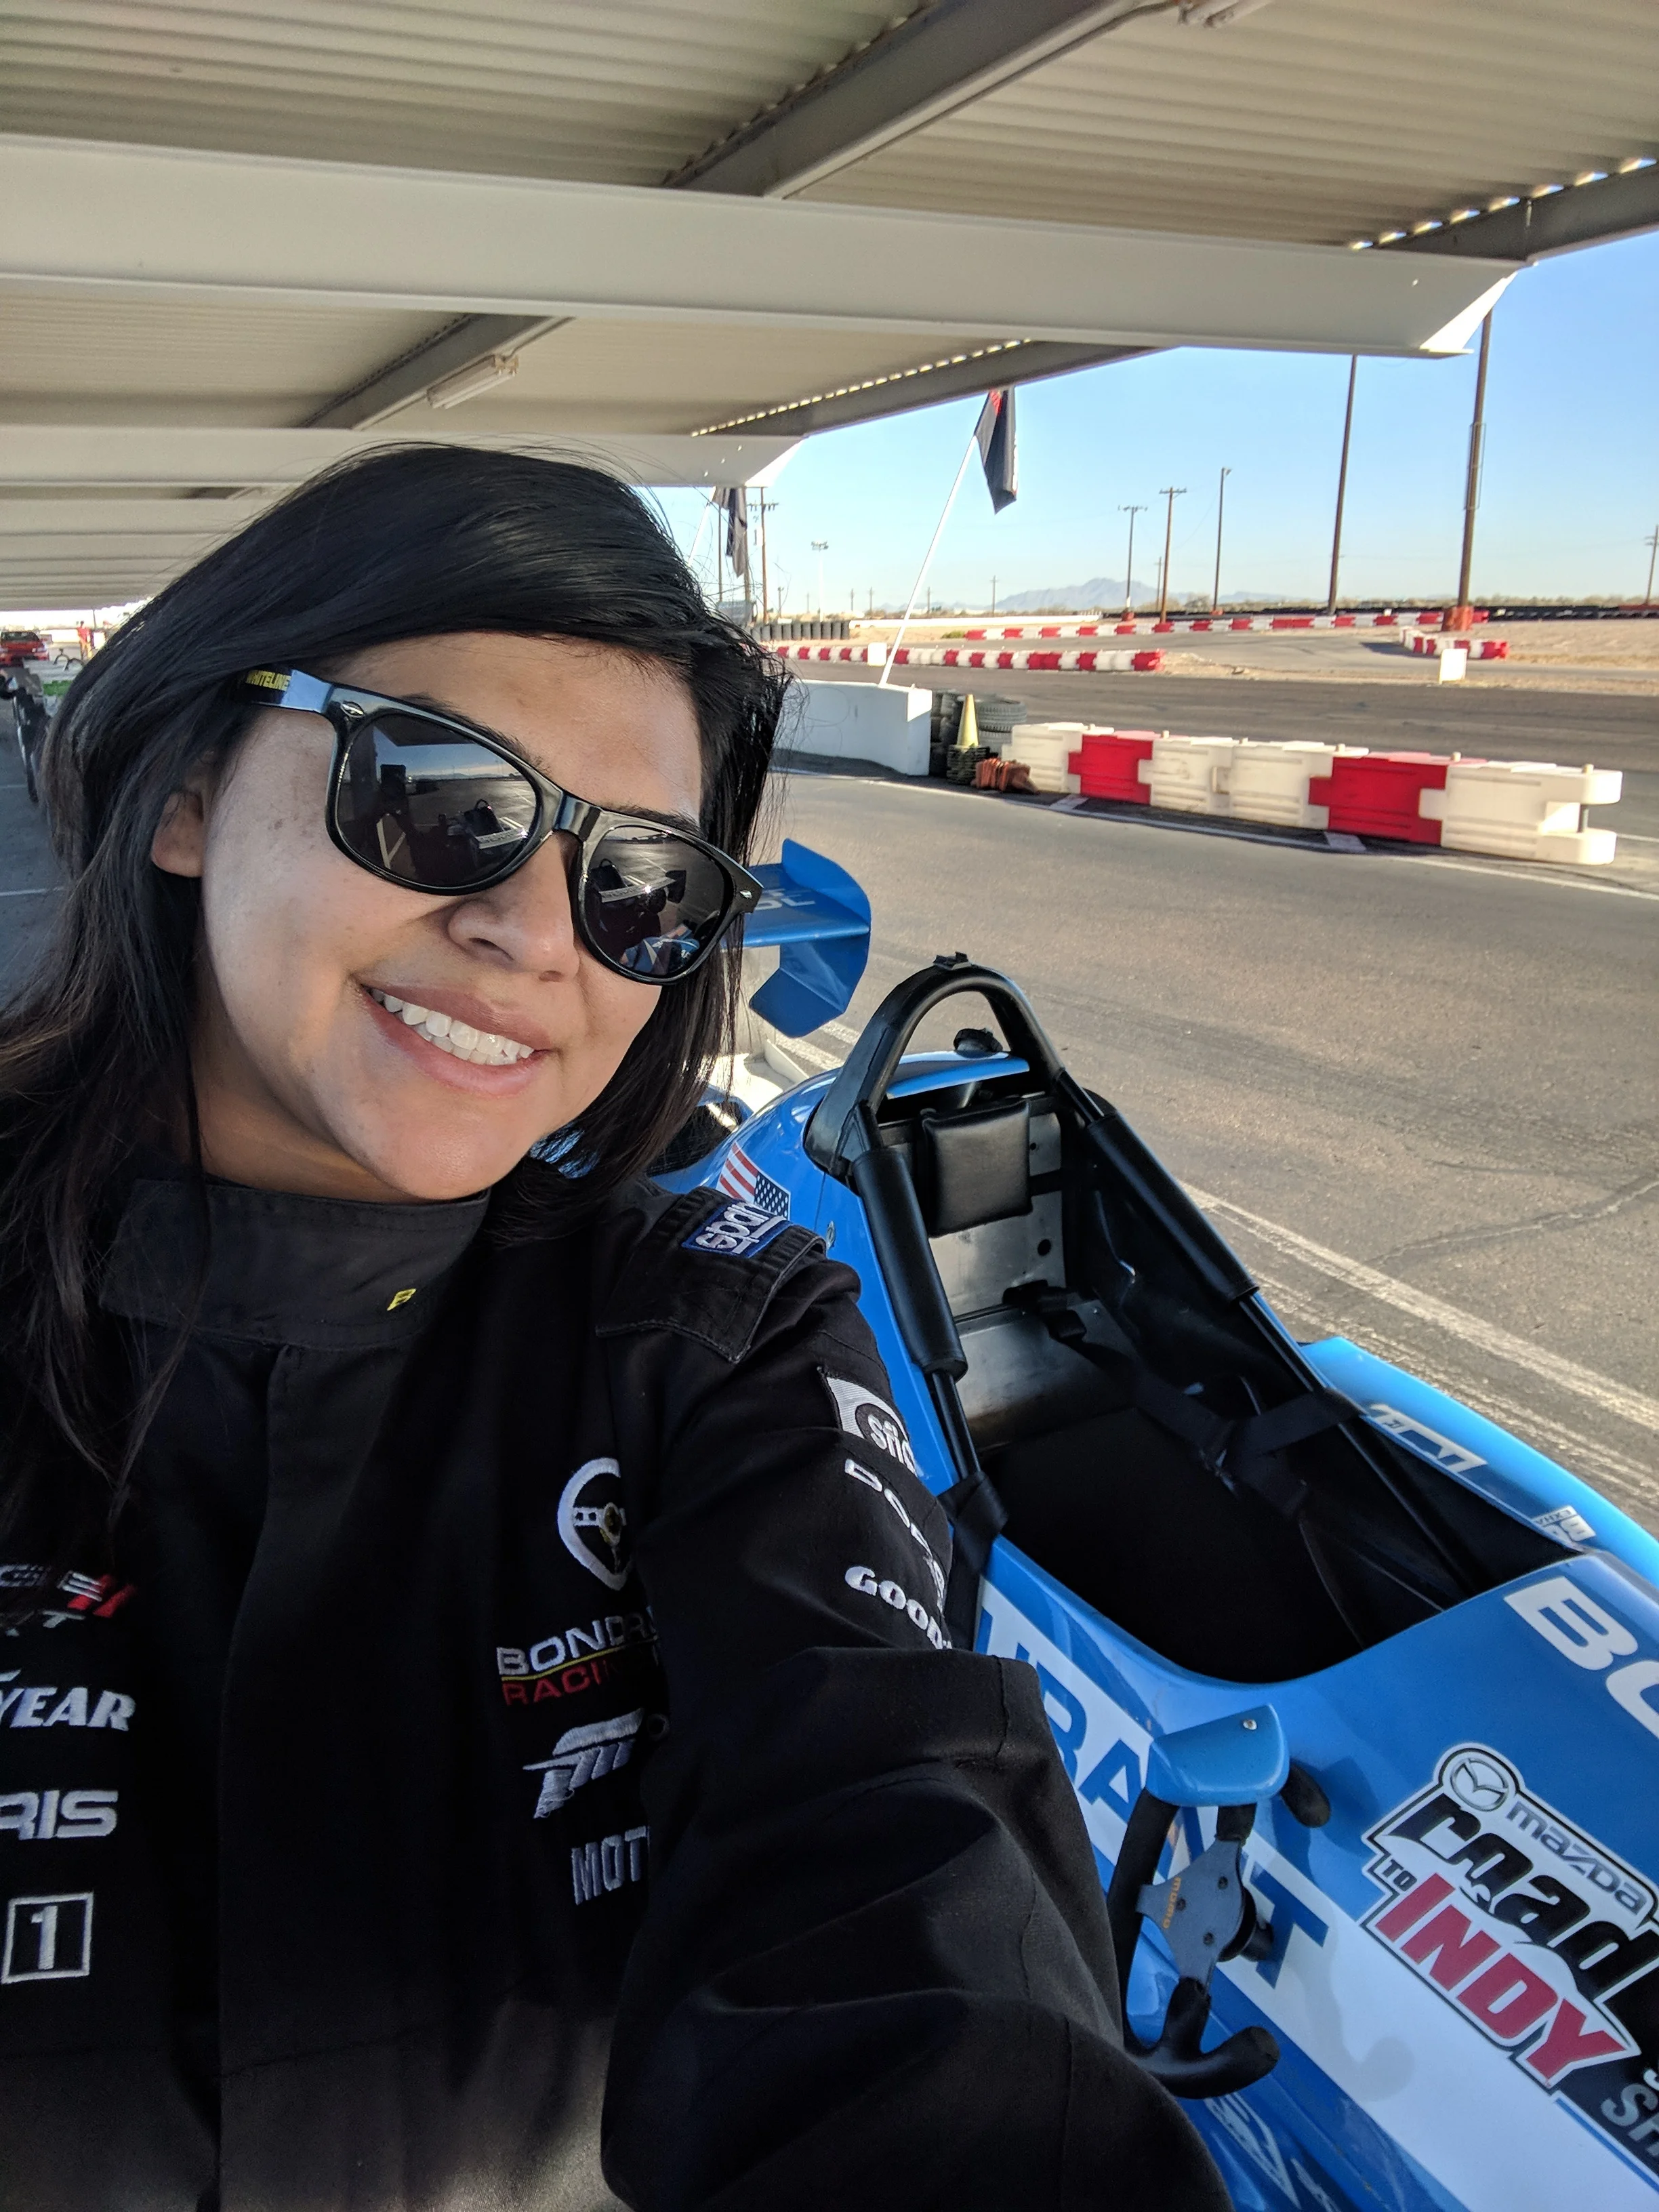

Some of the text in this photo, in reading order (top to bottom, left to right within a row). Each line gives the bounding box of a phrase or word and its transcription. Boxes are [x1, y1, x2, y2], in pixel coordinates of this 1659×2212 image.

[844, 1565, 953, 1650] GOOD
[501, 1660, 609, 1706] RACI
[1380, 1858, 1418, 1892] TO
[1387, 1793, 1659, 2001] road
[1506, 1800, 1647, 1917] mazda
[30, 1905, 58, 1970] 1
[1374, 1872, 1626, 2087] INDY
